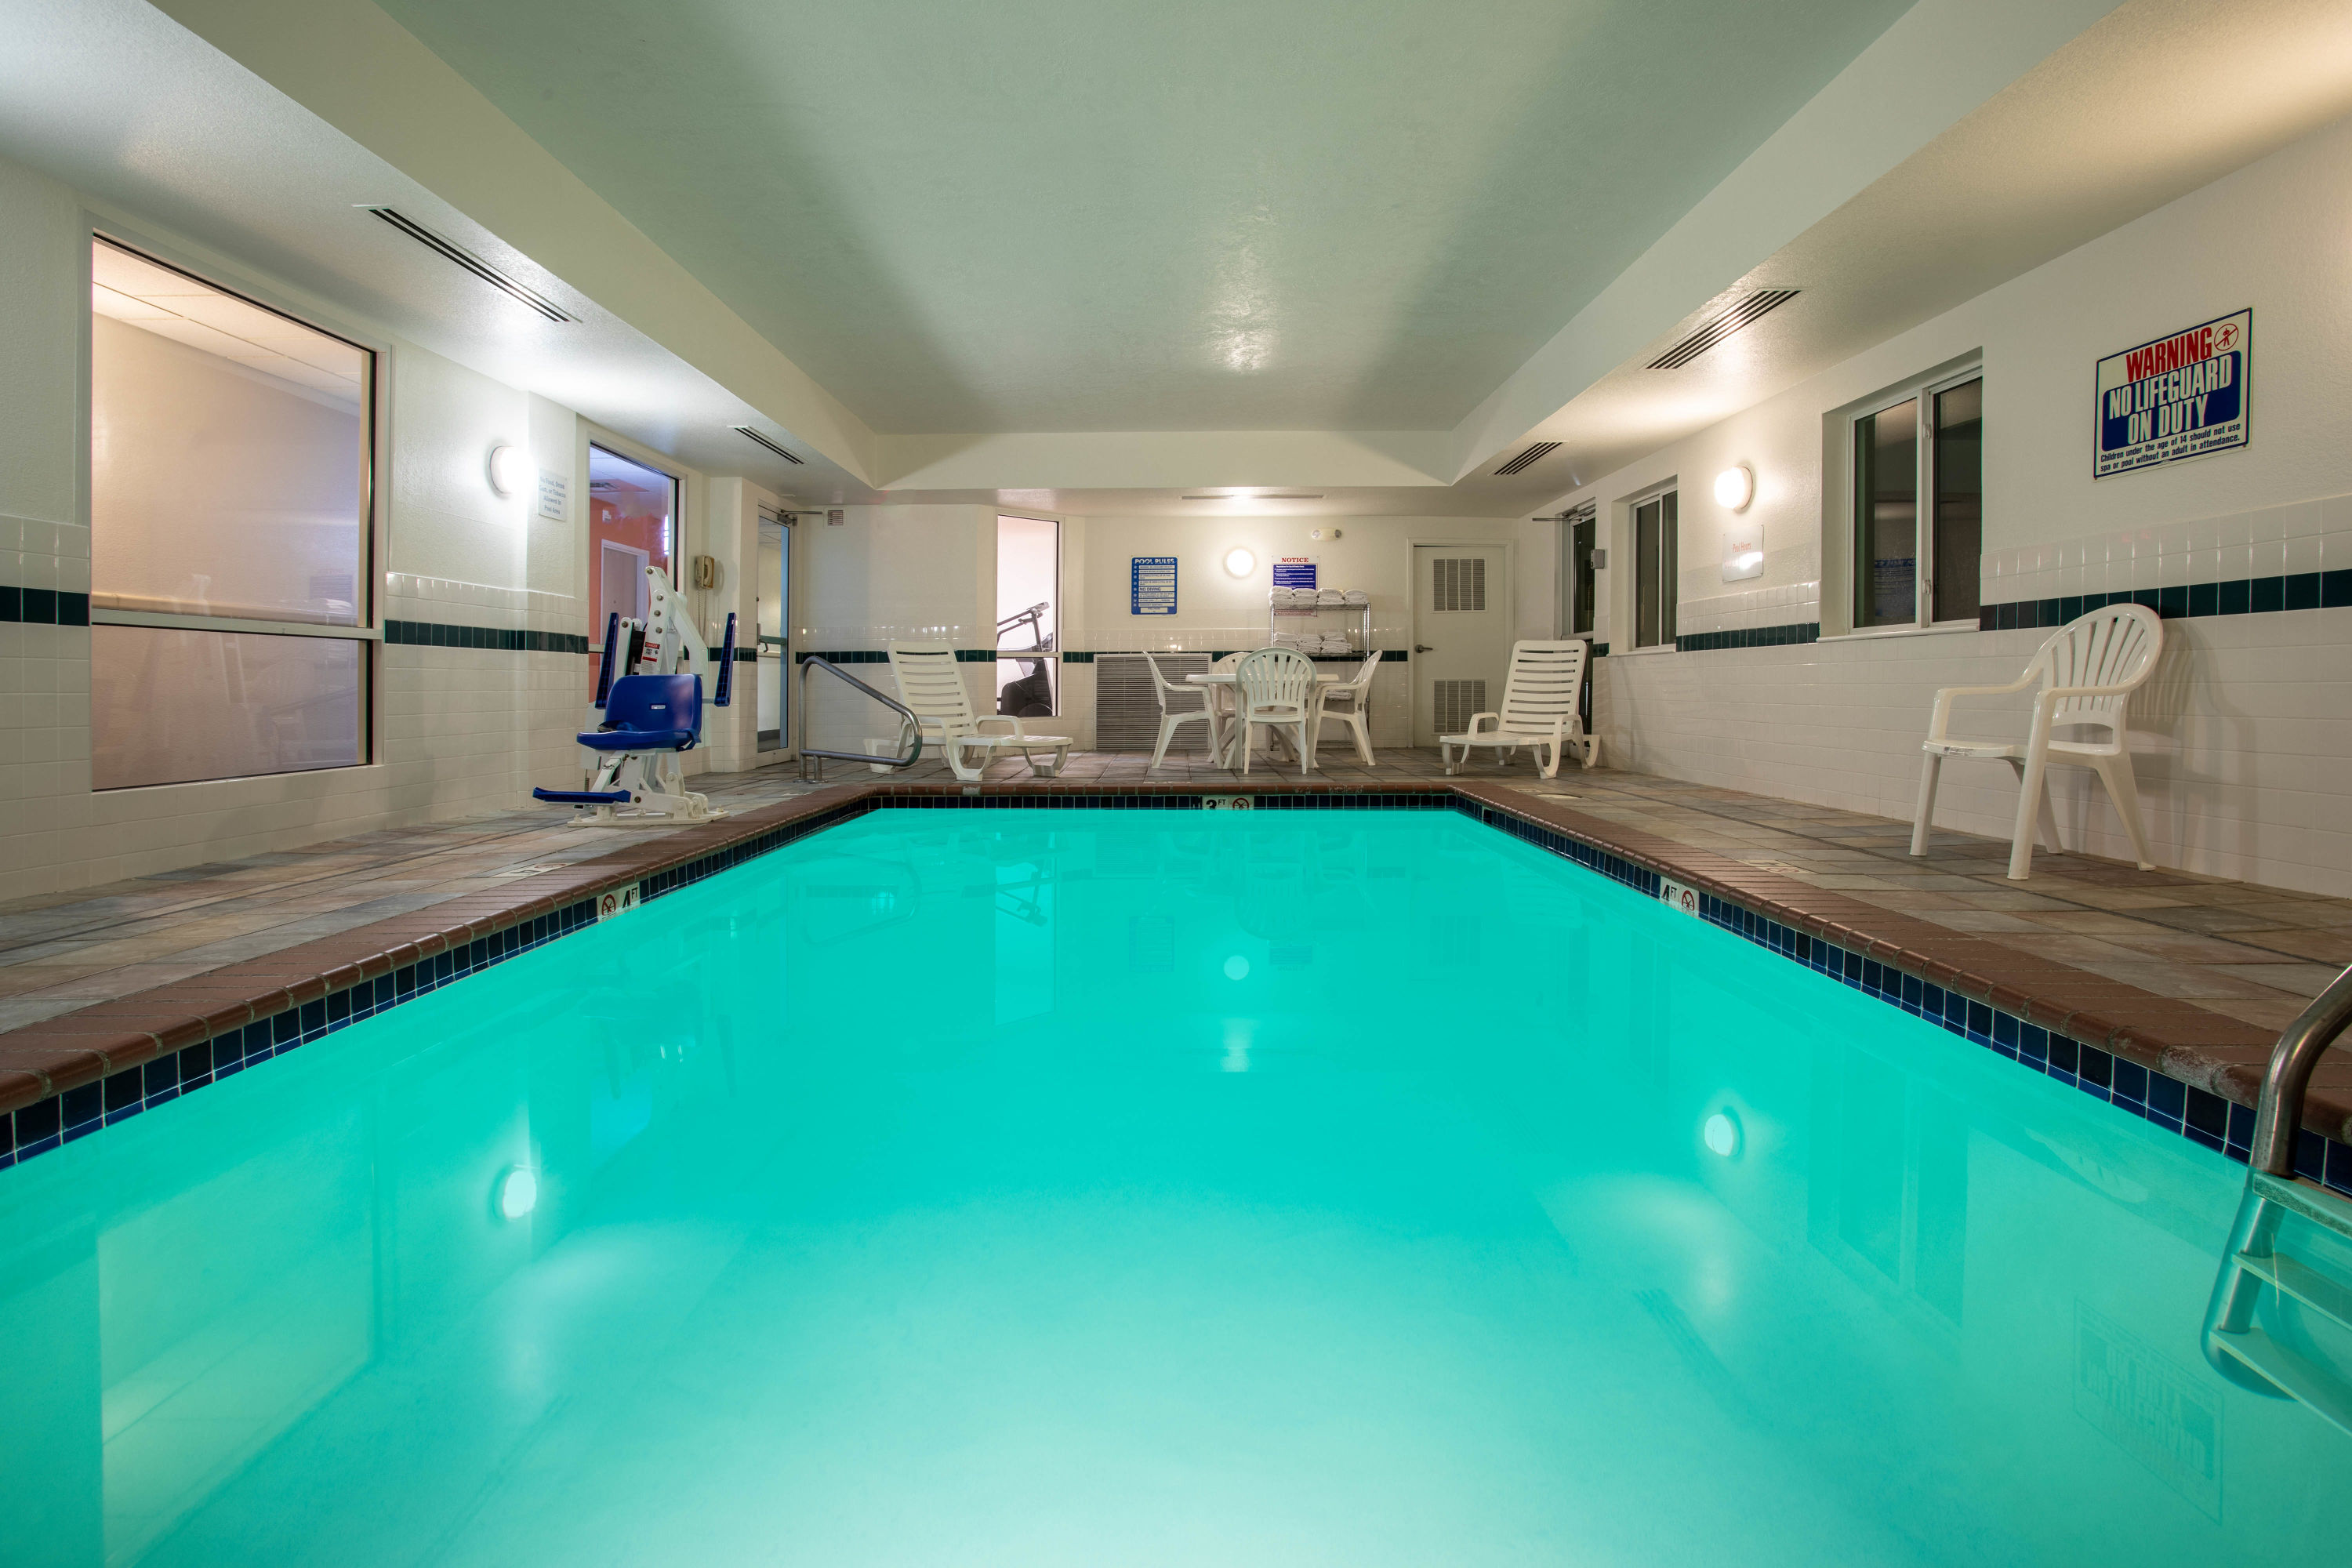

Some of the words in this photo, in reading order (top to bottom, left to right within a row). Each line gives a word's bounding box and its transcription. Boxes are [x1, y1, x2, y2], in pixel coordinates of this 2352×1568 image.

[2125, 327, 2212, 383] WARNING
[2109, 386, 2132, 419] NO
[2135, 354, 2233, 412] LIFEGUARD
[2128, 409, 2151, 445] ON
[2158, 394, 2209, 437] DUTY
[2100, 452, 2124, 463] Children
[2125, 447, 2143, 456] under
[2144, 443, 2155, 452] the
[2157, 440, 2169, 450] age
[2170, 437, 2178, 445] of
[2180, 434, 2187, 444] 14
[2189, 428, 2211, 441] should
[2213, 425, 2226, 436] not
[2227, 423, 2241, 432] use
[2100, 463, 2111, 472] spa
[2121, 457, 2134, 468] pool
[2136, 452, 2159, 463] without
[2171, 445, 2188, 456] adult
[2190, 443, 2197, 452] in
[2198, 434, 2240, 449] attendance.
[631, 887, 638, 899] FT
[1671, 886, 1677, 898] FT
